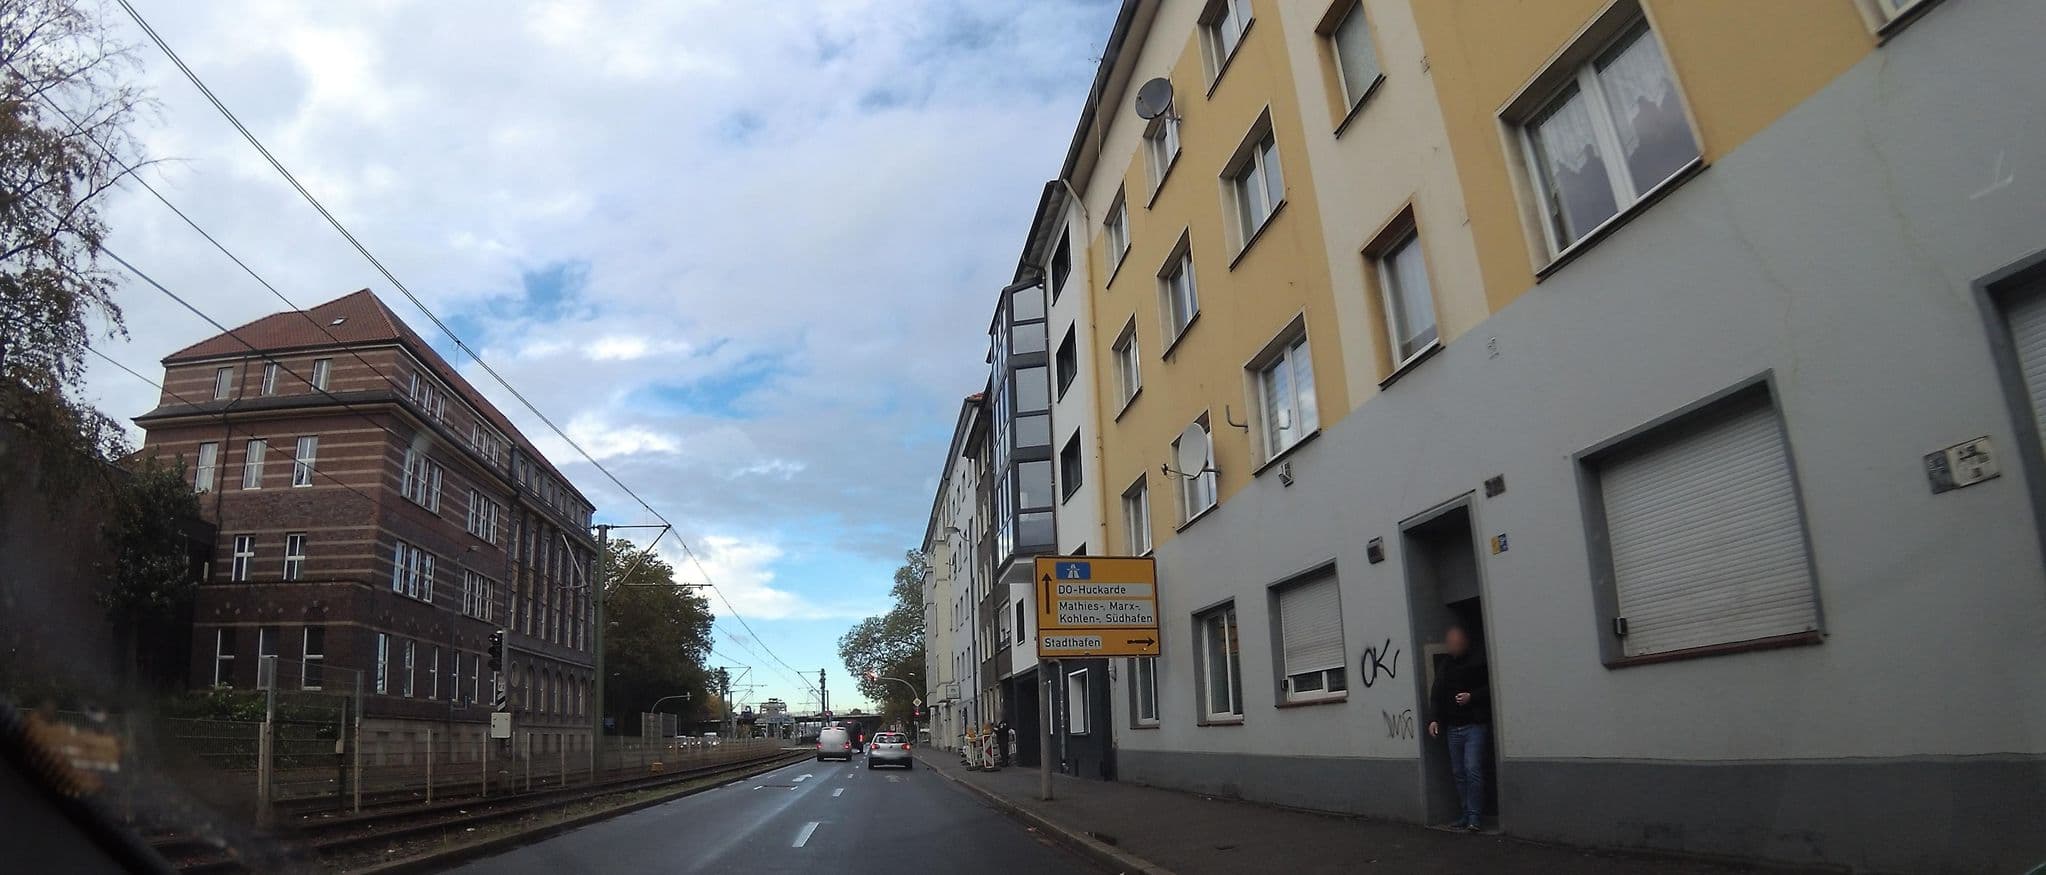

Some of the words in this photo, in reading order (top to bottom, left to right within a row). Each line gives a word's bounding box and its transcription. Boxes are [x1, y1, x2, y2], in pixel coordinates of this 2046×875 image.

[1058, 585, 1126, 595] DO-Huckarde
[1105, 613, 1153, 623] Südhafen
[1044, 637, 1101, 648] Stadthafen
